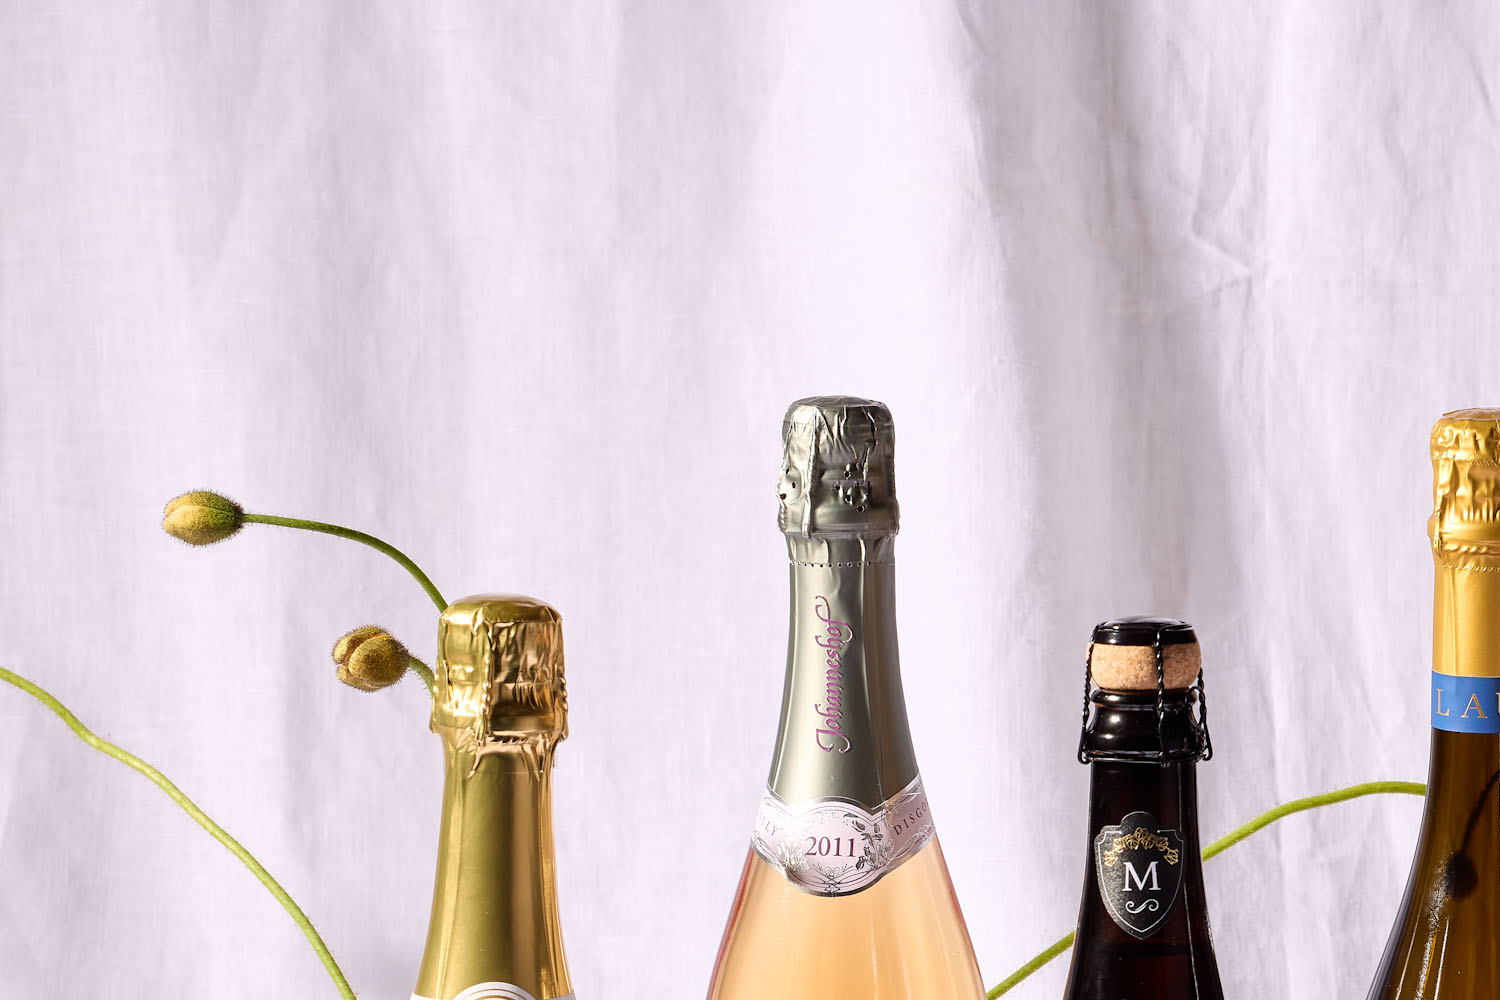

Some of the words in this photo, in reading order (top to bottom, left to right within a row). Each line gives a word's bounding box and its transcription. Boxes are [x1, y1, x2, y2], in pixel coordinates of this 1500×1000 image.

[814, 595, 853, 754] Johanneshof
[805, 836, 857, 857] 2011
[1121, 861, 1162, 891] M
